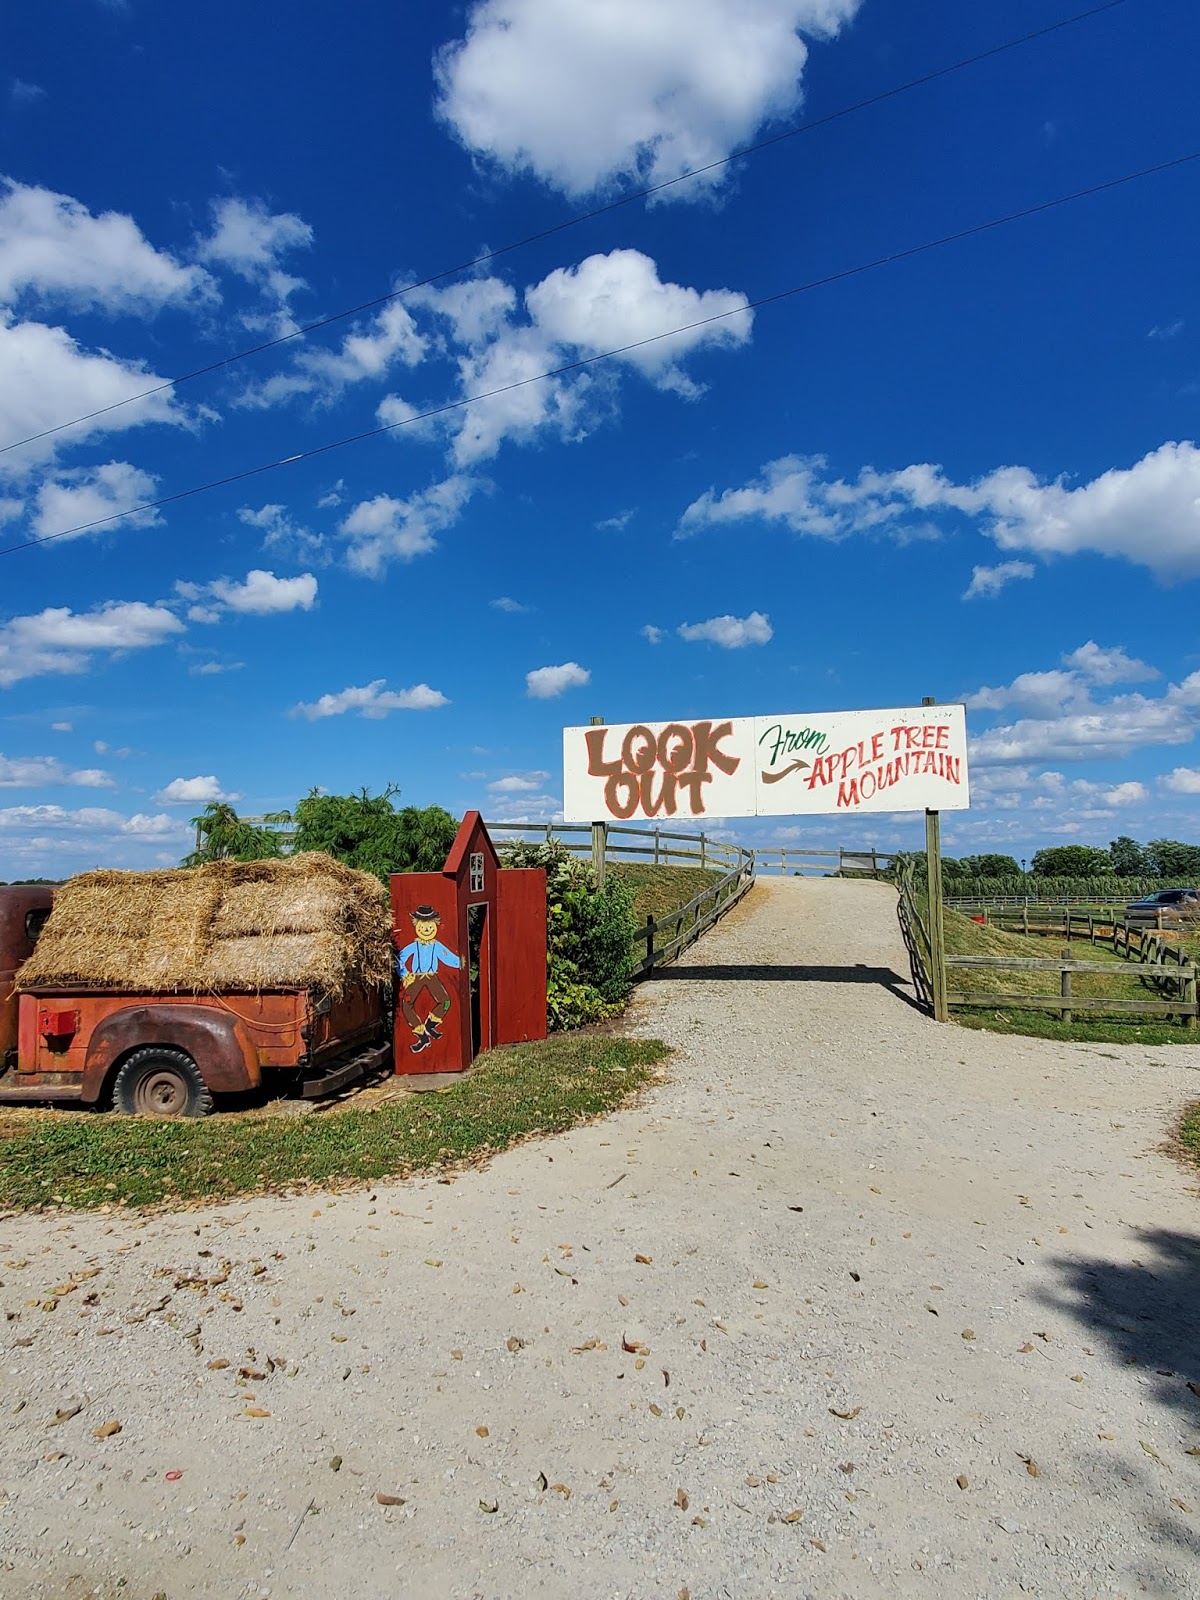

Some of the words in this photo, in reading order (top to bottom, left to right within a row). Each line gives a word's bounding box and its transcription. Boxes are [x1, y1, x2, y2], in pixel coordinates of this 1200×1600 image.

[584, 721, 741, 777] LOOK
[758, 724, 831, 766] From
[803, 731, 885, 790] APPLE
[890, 725, 951, 751] TREE
[604, 770, 713, 819] OUT
[836, 750, 961, 807] MOUNTAIN
